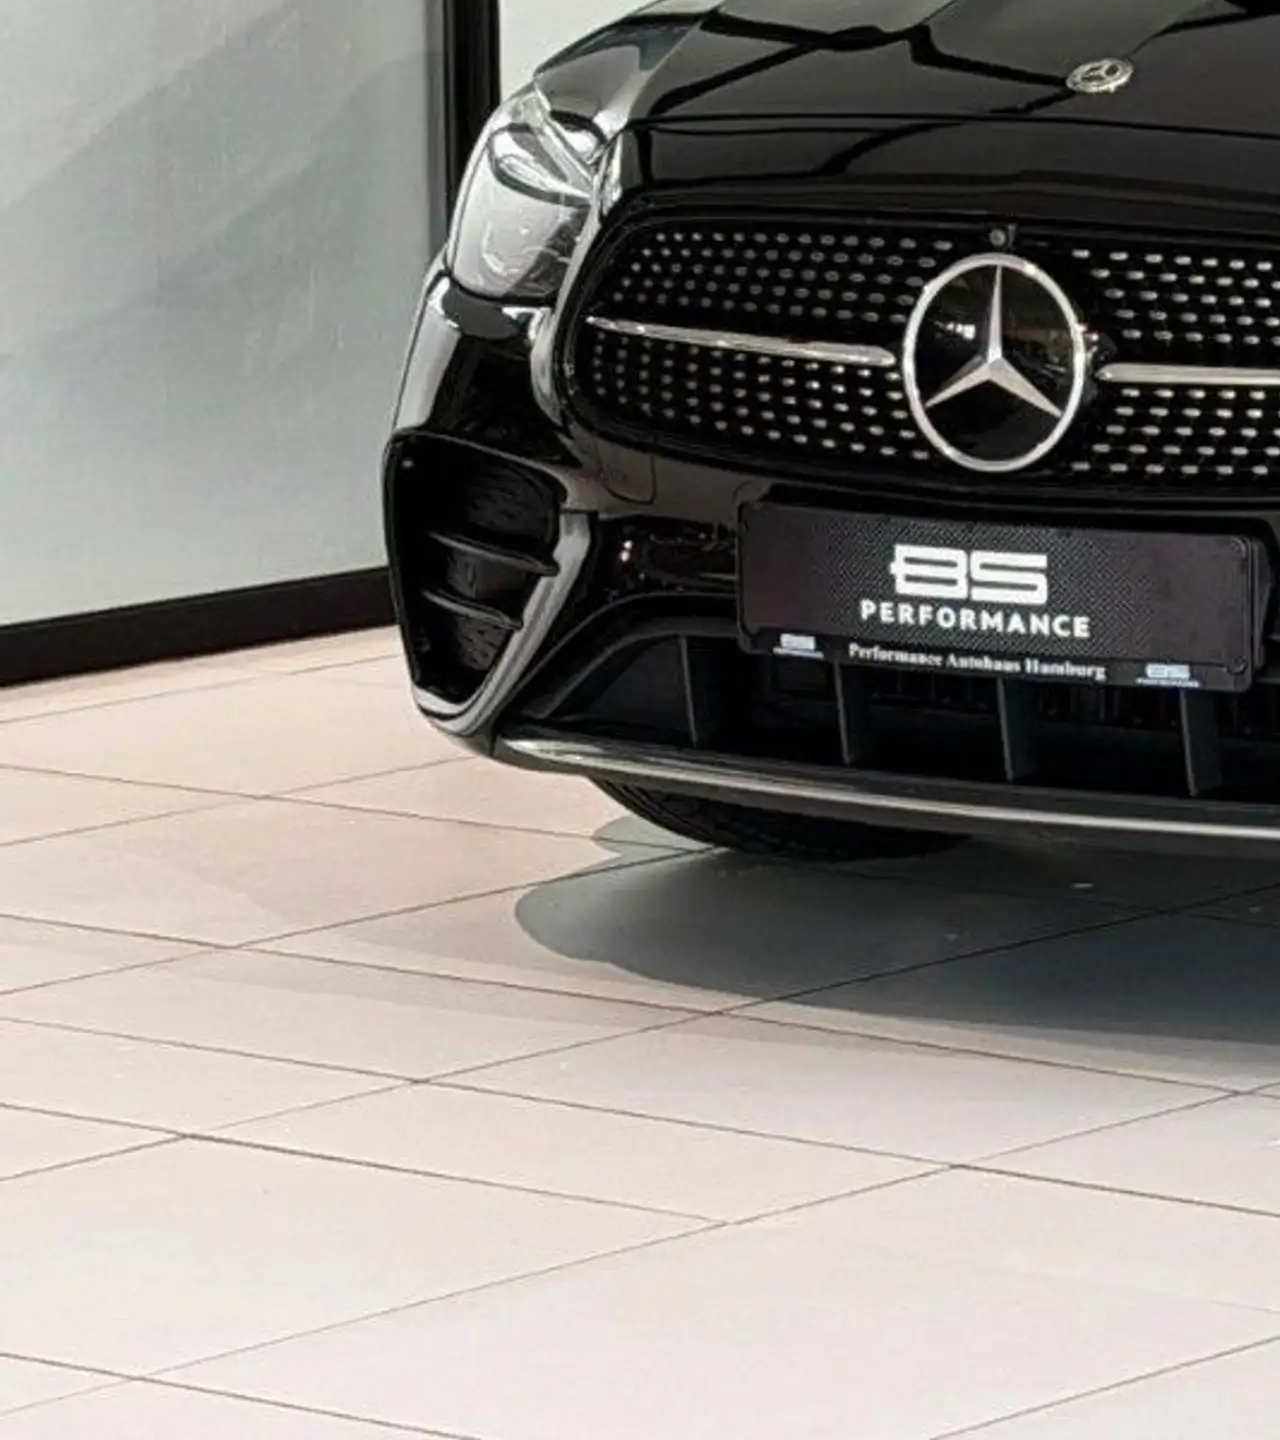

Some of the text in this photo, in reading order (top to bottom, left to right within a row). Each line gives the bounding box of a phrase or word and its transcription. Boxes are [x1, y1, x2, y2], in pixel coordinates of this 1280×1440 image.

[889, 543, 1048, 605] BS
[859, 598, 1091, 639] PERFORMANCE
[848, 642, 943, 666] Performance
[946, 652, 1021, 673] Autohaus
[1024, 657, 1107, 681] Hamburg
